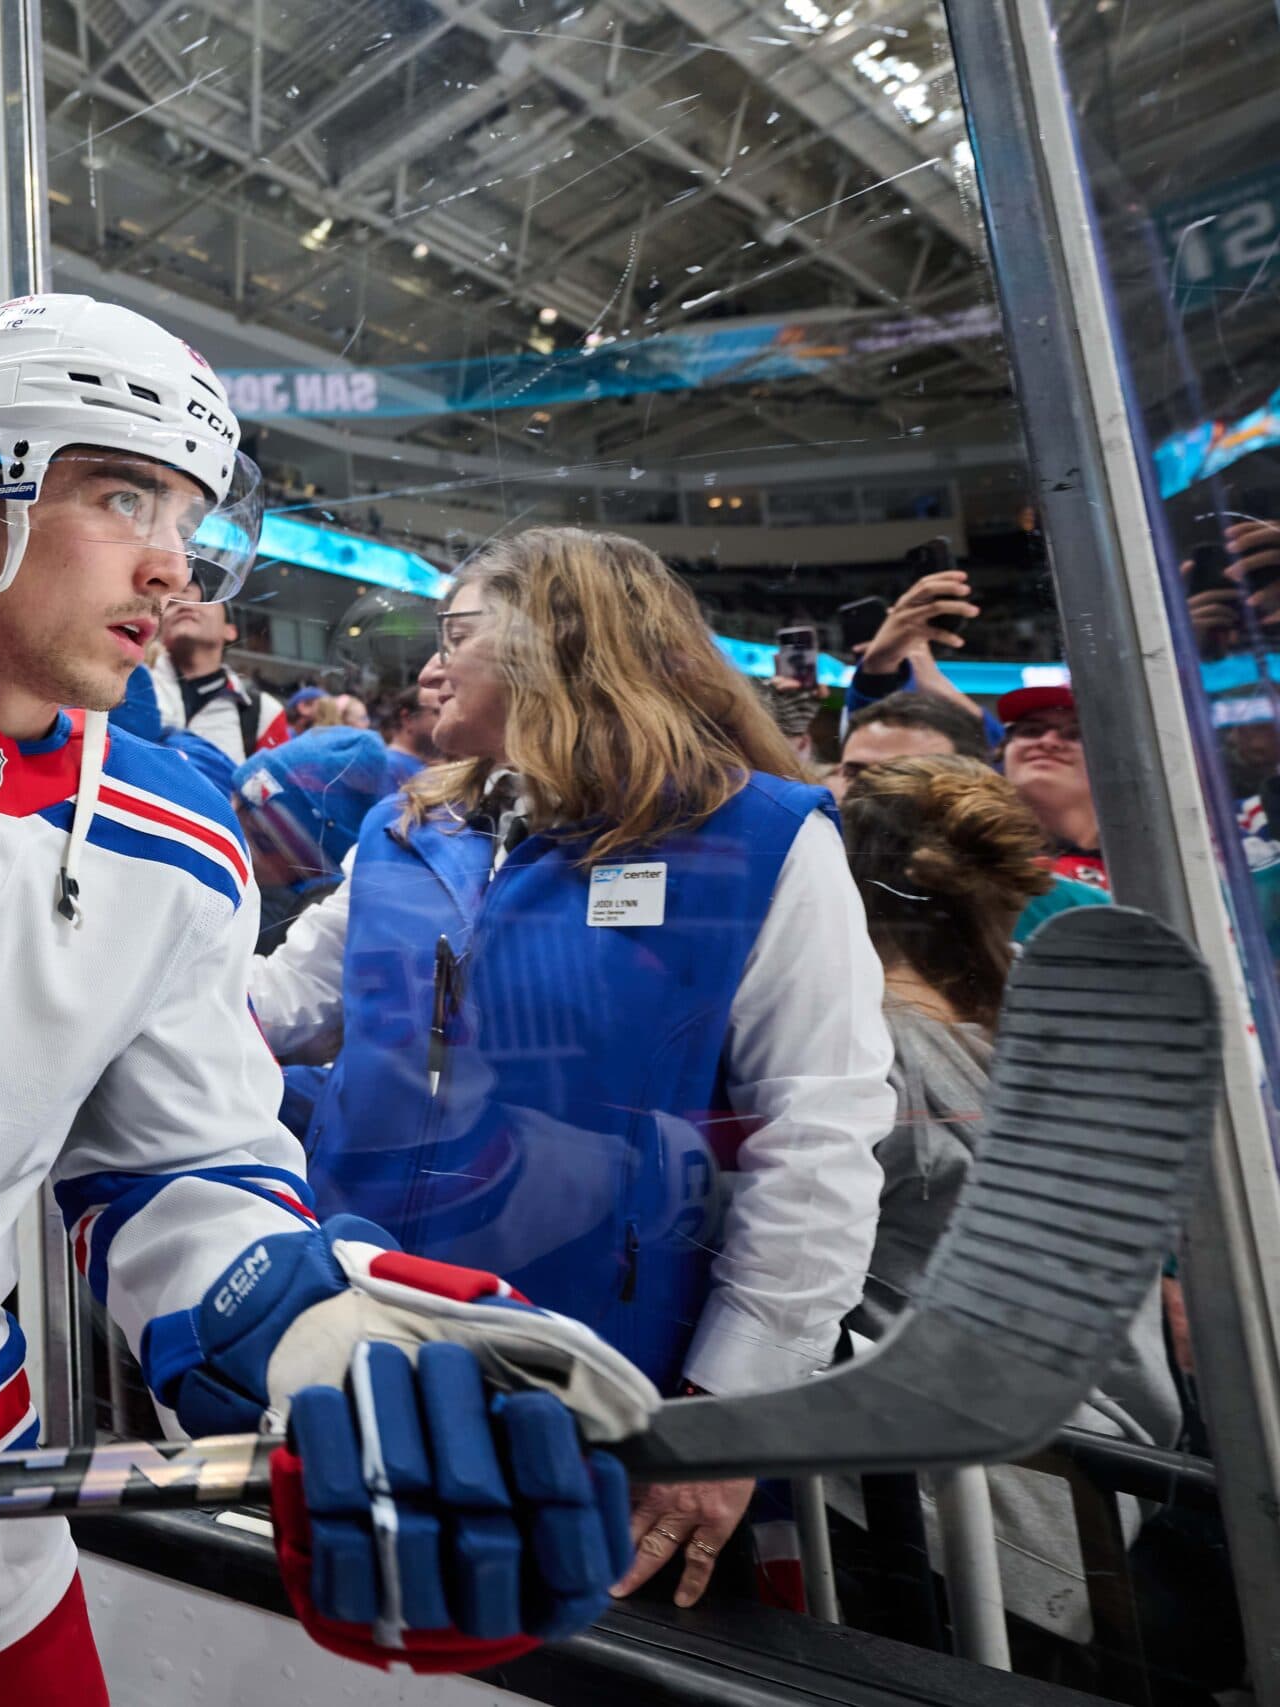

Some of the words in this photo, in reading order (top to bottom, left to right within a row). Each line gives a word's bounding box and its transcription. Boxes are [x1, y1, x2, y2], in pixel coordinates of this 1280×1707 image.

[186, 399, 235, 445] CCM
[623, 870, 662, 880] center
[213, 1243, 269, 1313] CCM
